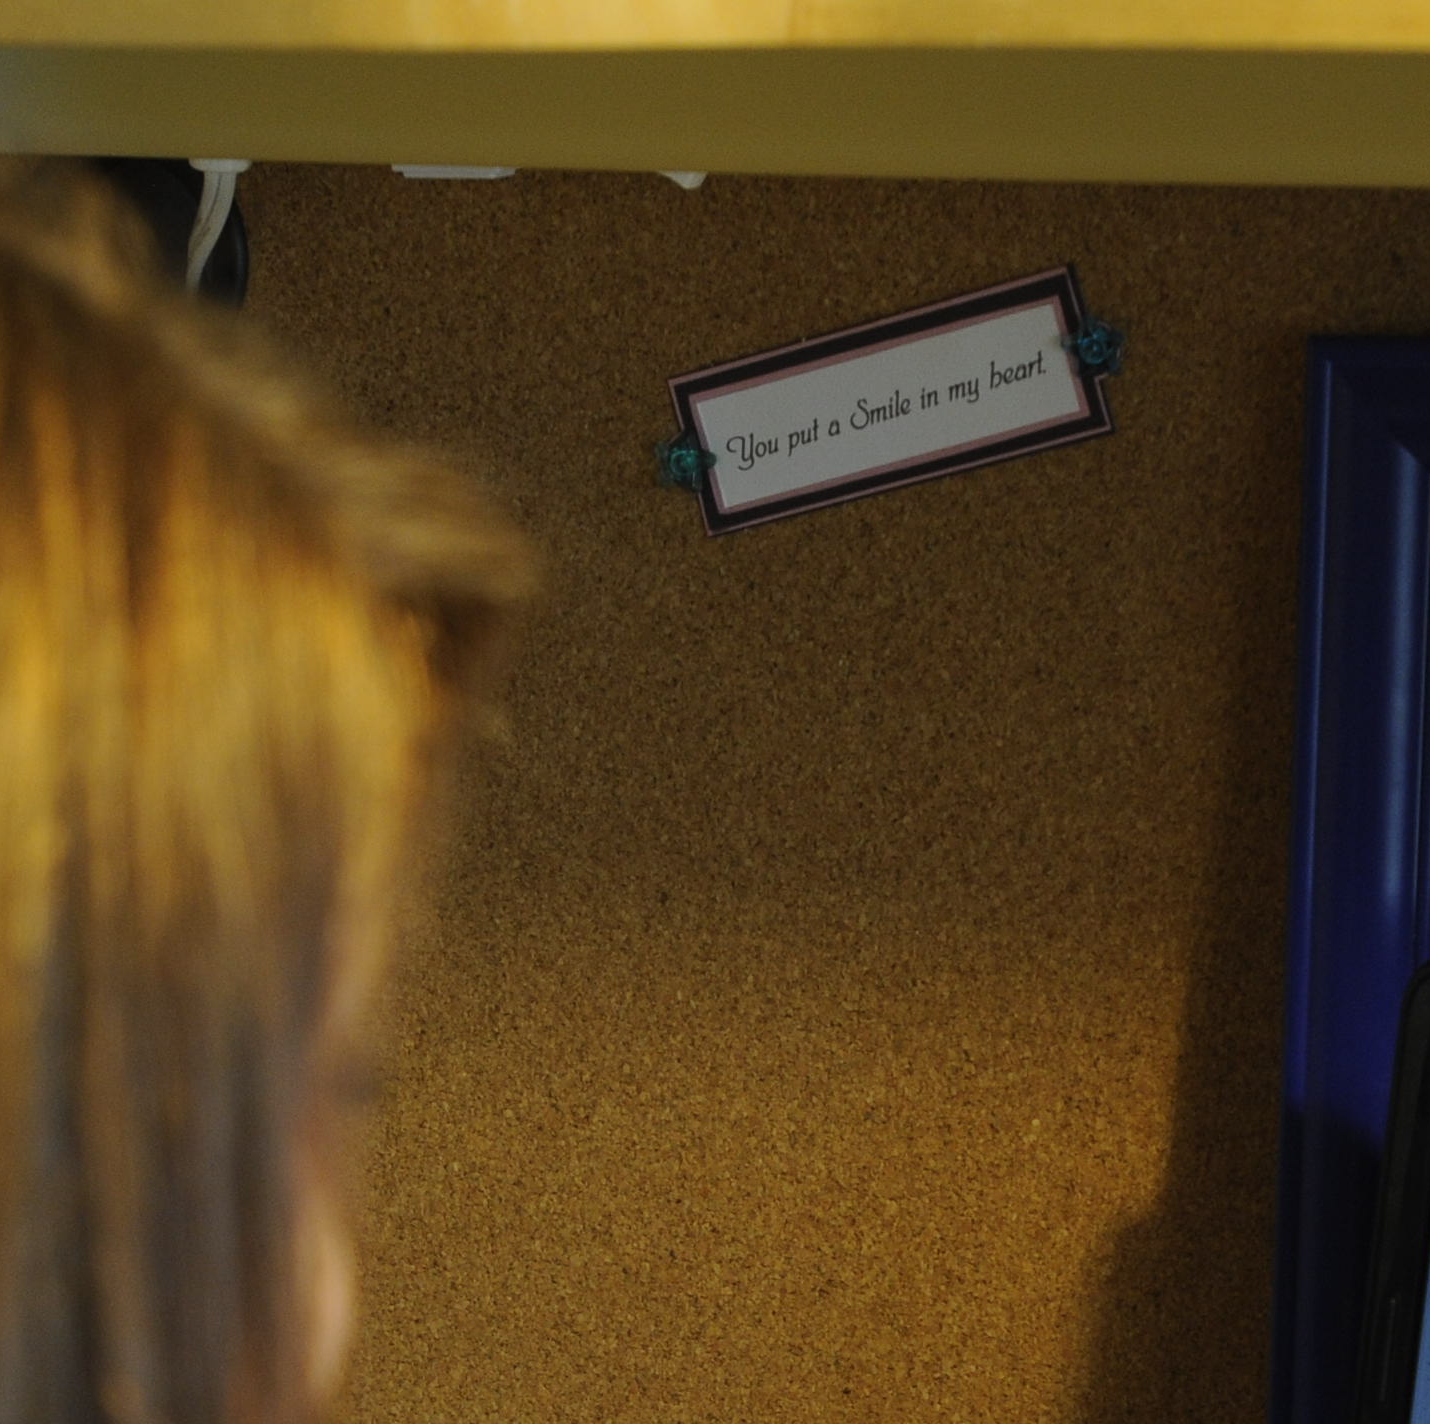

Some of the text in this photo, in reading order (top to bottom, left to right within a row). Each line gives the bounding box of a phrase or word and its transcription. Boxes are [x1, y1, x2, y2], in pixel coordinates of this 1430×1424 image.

[726, 434, 779, 471] You
[787, 418, 819, 456] put
[828, 419, 841, 437] a
[850, 390, 911, 430] Smile
[920, 386, 940, 411] in
[948, 377, 980, 403] my
